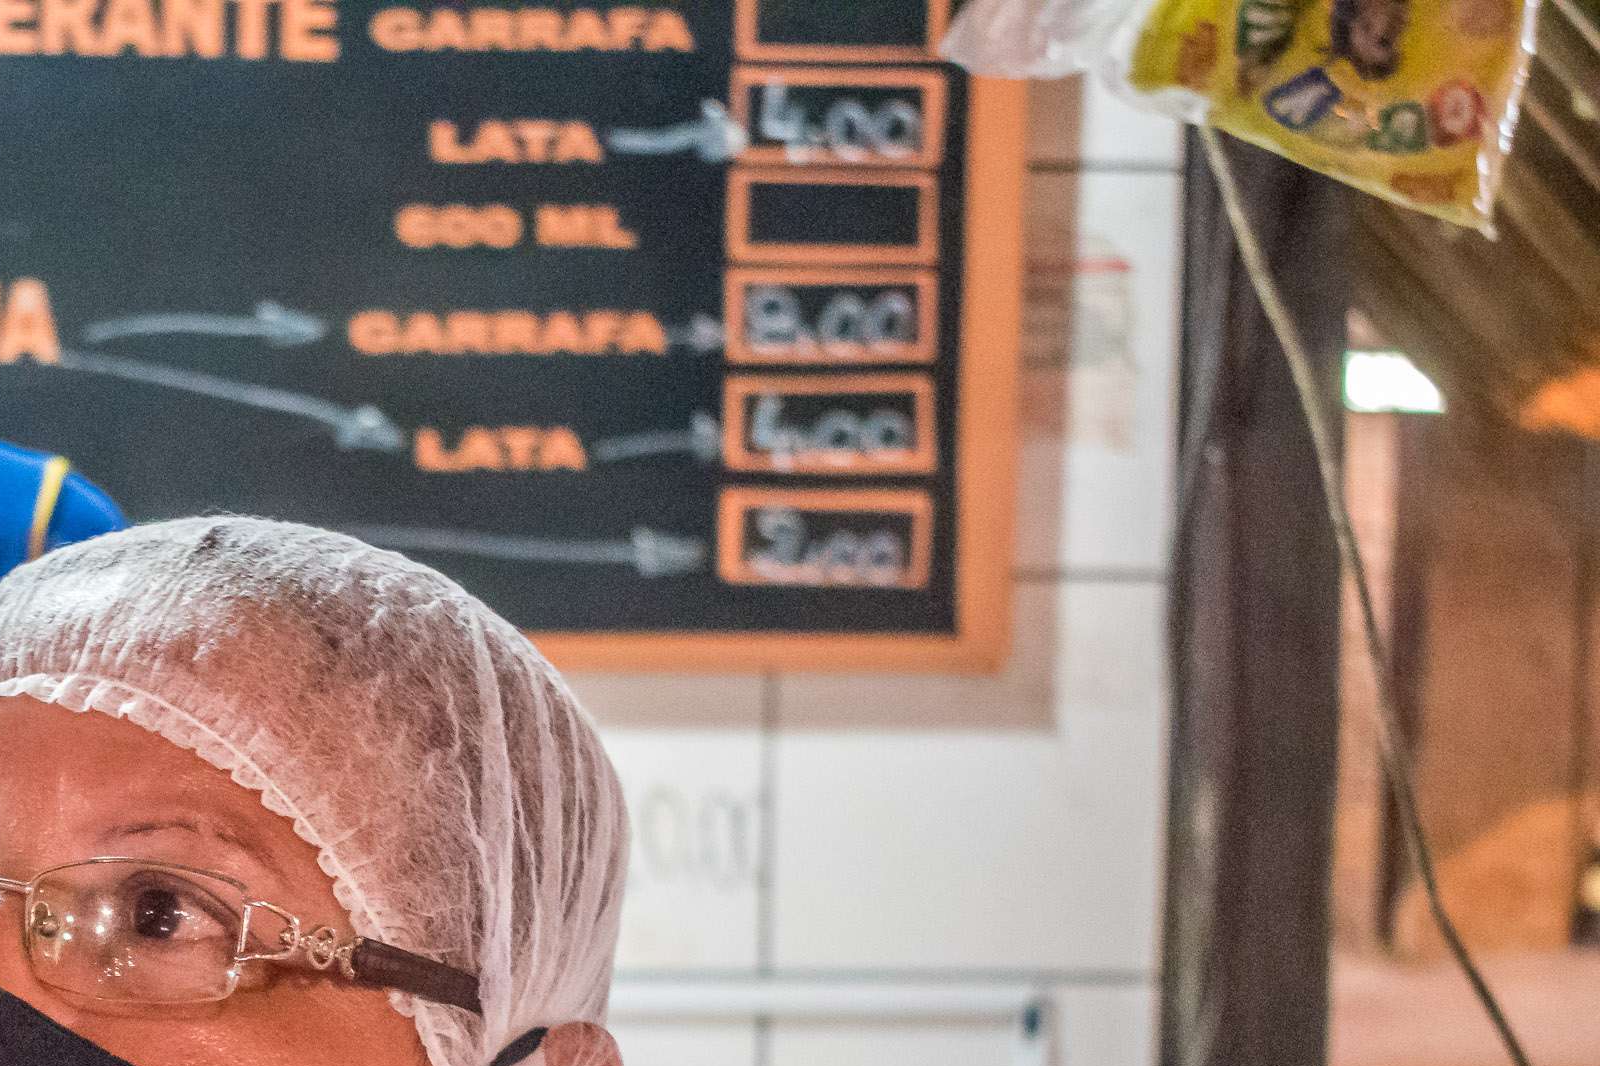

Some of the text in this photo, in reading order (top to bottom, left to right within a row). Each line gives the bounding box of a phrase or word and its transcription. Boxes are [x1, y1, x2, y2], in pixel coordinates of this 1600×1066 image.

[373, 9, 691, 50] GARRAFA
[432, 121, 600, 163] LATA
[350, 312, 664, 354] GARRAFA
[417, 428, 584, 470] LATA
